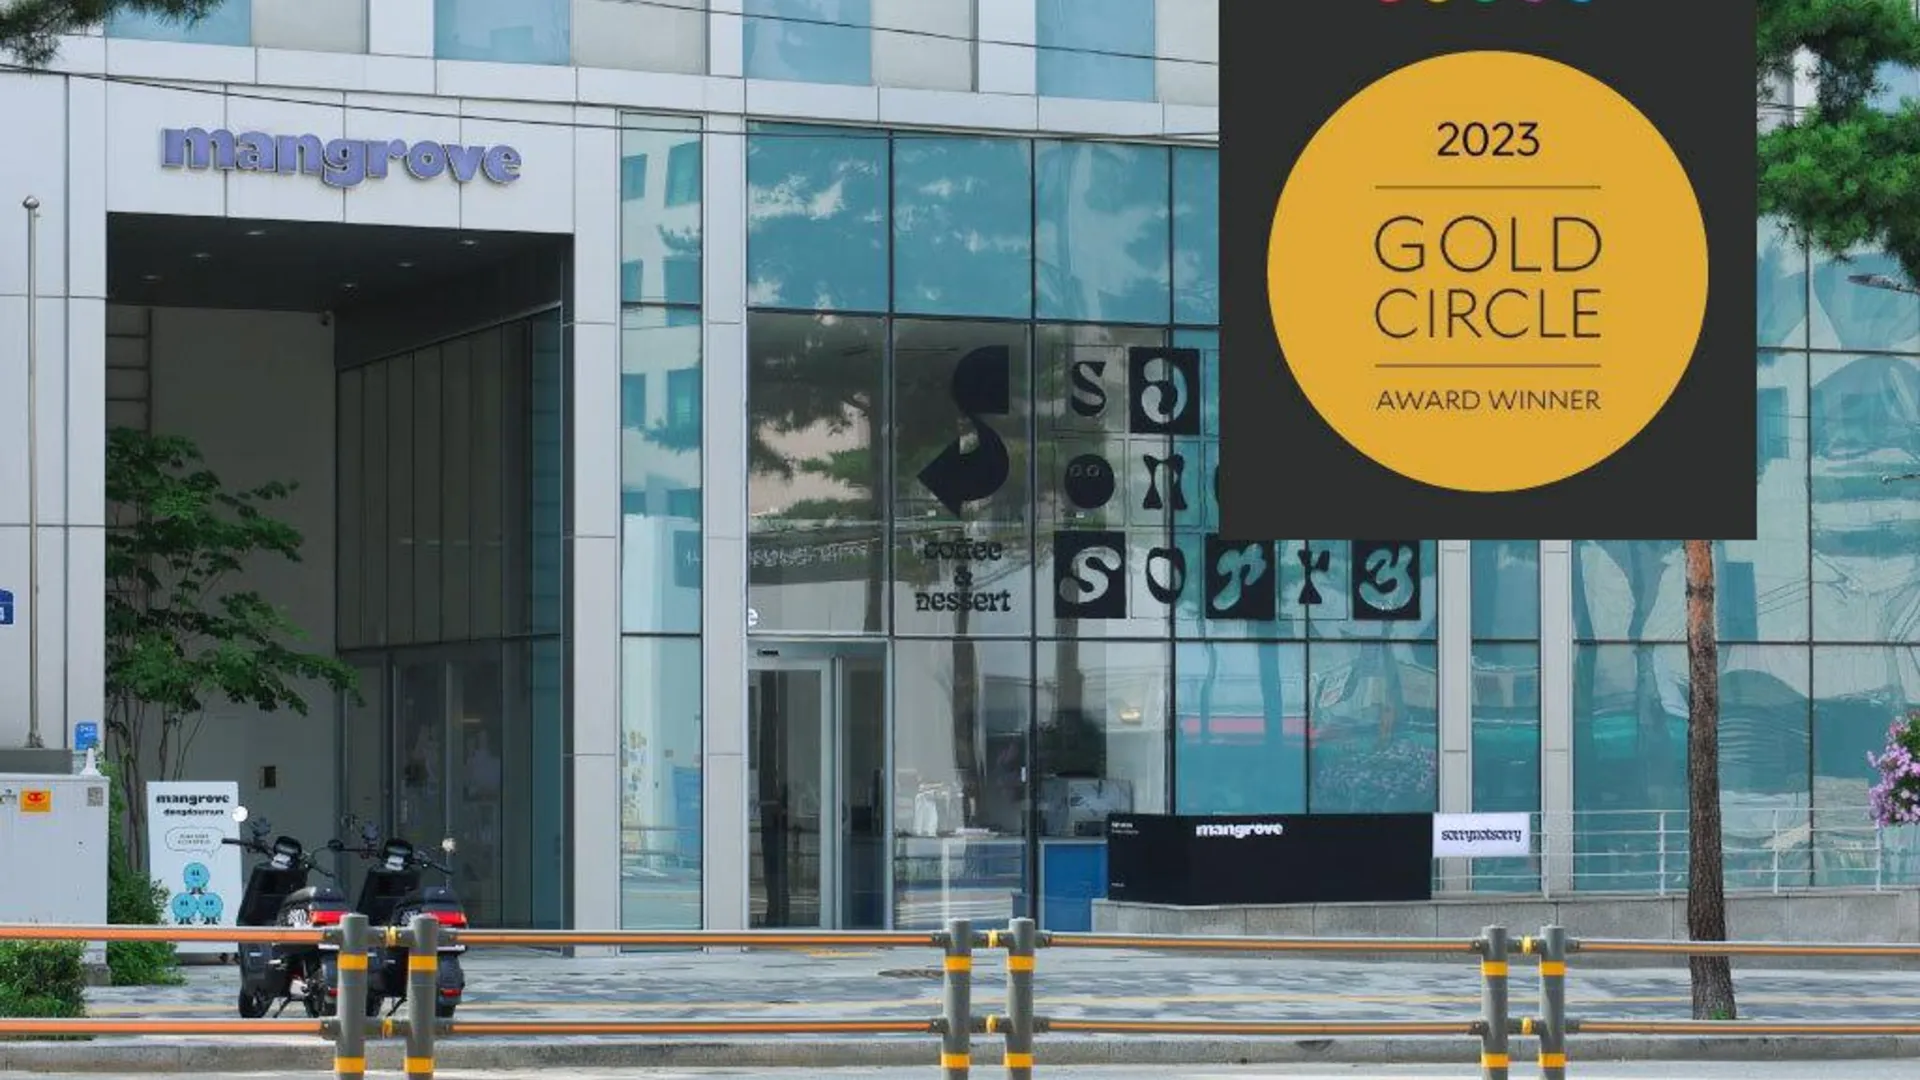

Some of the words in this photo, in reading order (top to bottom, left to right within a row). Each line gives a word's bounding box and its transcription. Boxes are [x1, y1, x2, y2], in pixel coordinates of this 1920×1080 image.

[161, 127, 523, 188] mangrove
[924, 538, 1003, 561] coffee
[954, 564, 973, 587] &
[156, 794, 230, 806] mangrove
[1195, 823, 1284, 839] mangrove
[1441, 828, 1523, 843] sorrynotsorry
